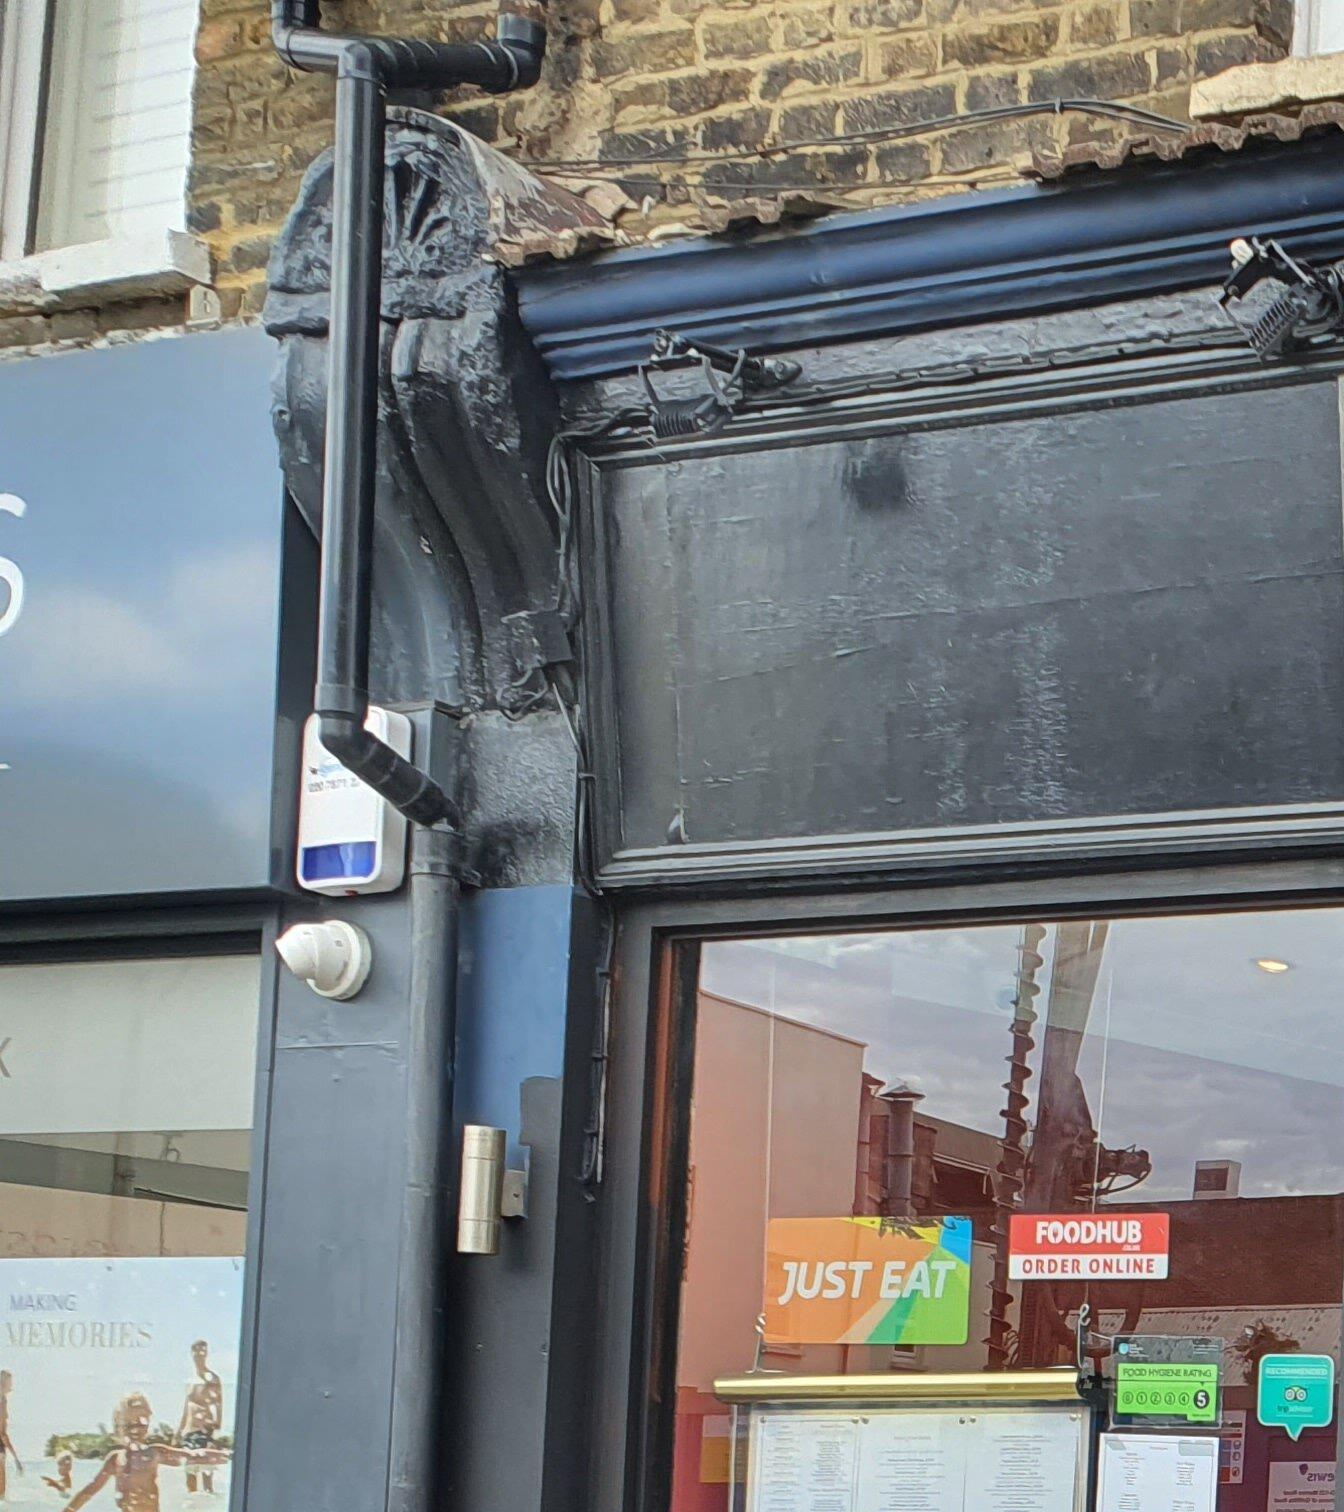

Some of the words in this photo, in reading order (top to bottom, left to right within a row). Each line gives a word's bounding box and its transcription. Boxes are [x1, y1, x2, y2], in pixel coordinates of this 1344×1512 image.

[1036, 1220, 1142, 1244] FOODHUB
[1022, 1259, 1081, 1274] ORDER
[1089, 1258, 1155, 1274] ONLINE
[778, 1261, 873, 1305] JUST
[880, 1260, 956, 1299] EAT
[10, 1294, 77, 1311] MAKING
[6, 1321, 153, 1347] MEMORIES
[1122, 1368, 1146, 1377] FOOD
[1148, 1368, 1181, 1377] HYGIENE
[1183, 1369, 1212, 1378] RATING
[1265, 1367, 1328, 1377] RECOMMENDED
[1196, 1391, 1207, 1408] 5
